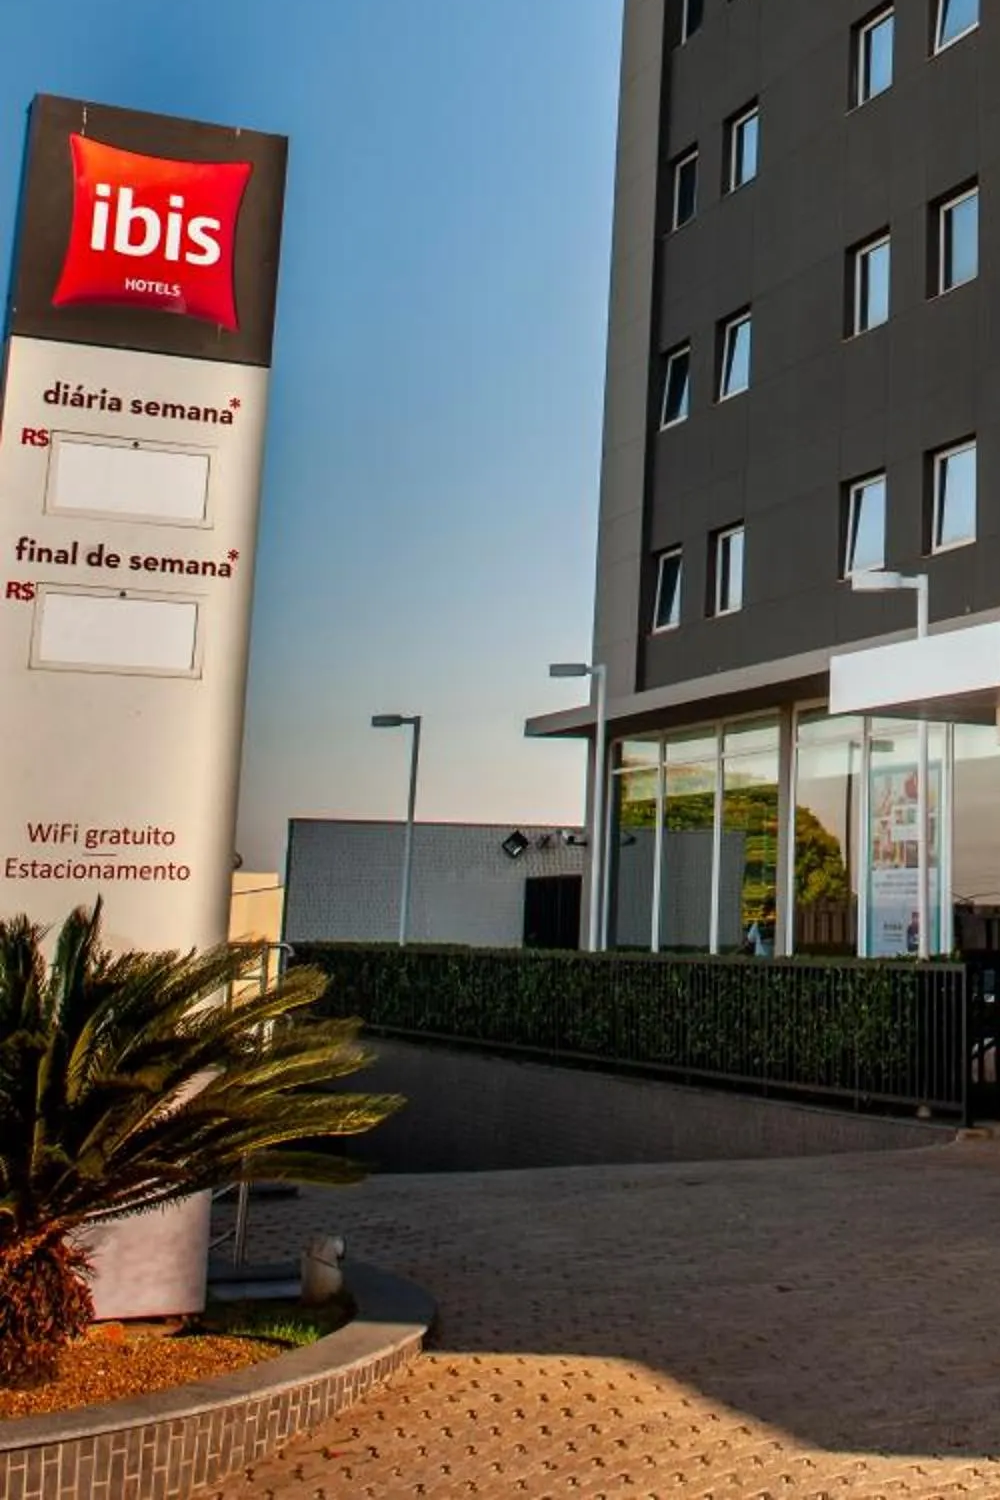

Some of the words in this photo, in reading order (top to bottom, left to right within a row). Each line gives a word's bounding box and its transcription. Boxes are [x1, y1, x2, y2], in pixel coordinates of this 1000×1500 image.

[91, 183, 221, 266] ibis
[125, 277, 181, 297] HOTELS
[43, 381, 122, 411] diária
[21, 428, 49, 448] R$
[15, 537, 78, 565] final
[86, 544, 120, 569] de
[5, 580, 35, 602] R$
[27, 822, 79, 843] WiFi
[84, 826, 176, 849] gratuito
[4, 857, 191, 881] Estacionamento
